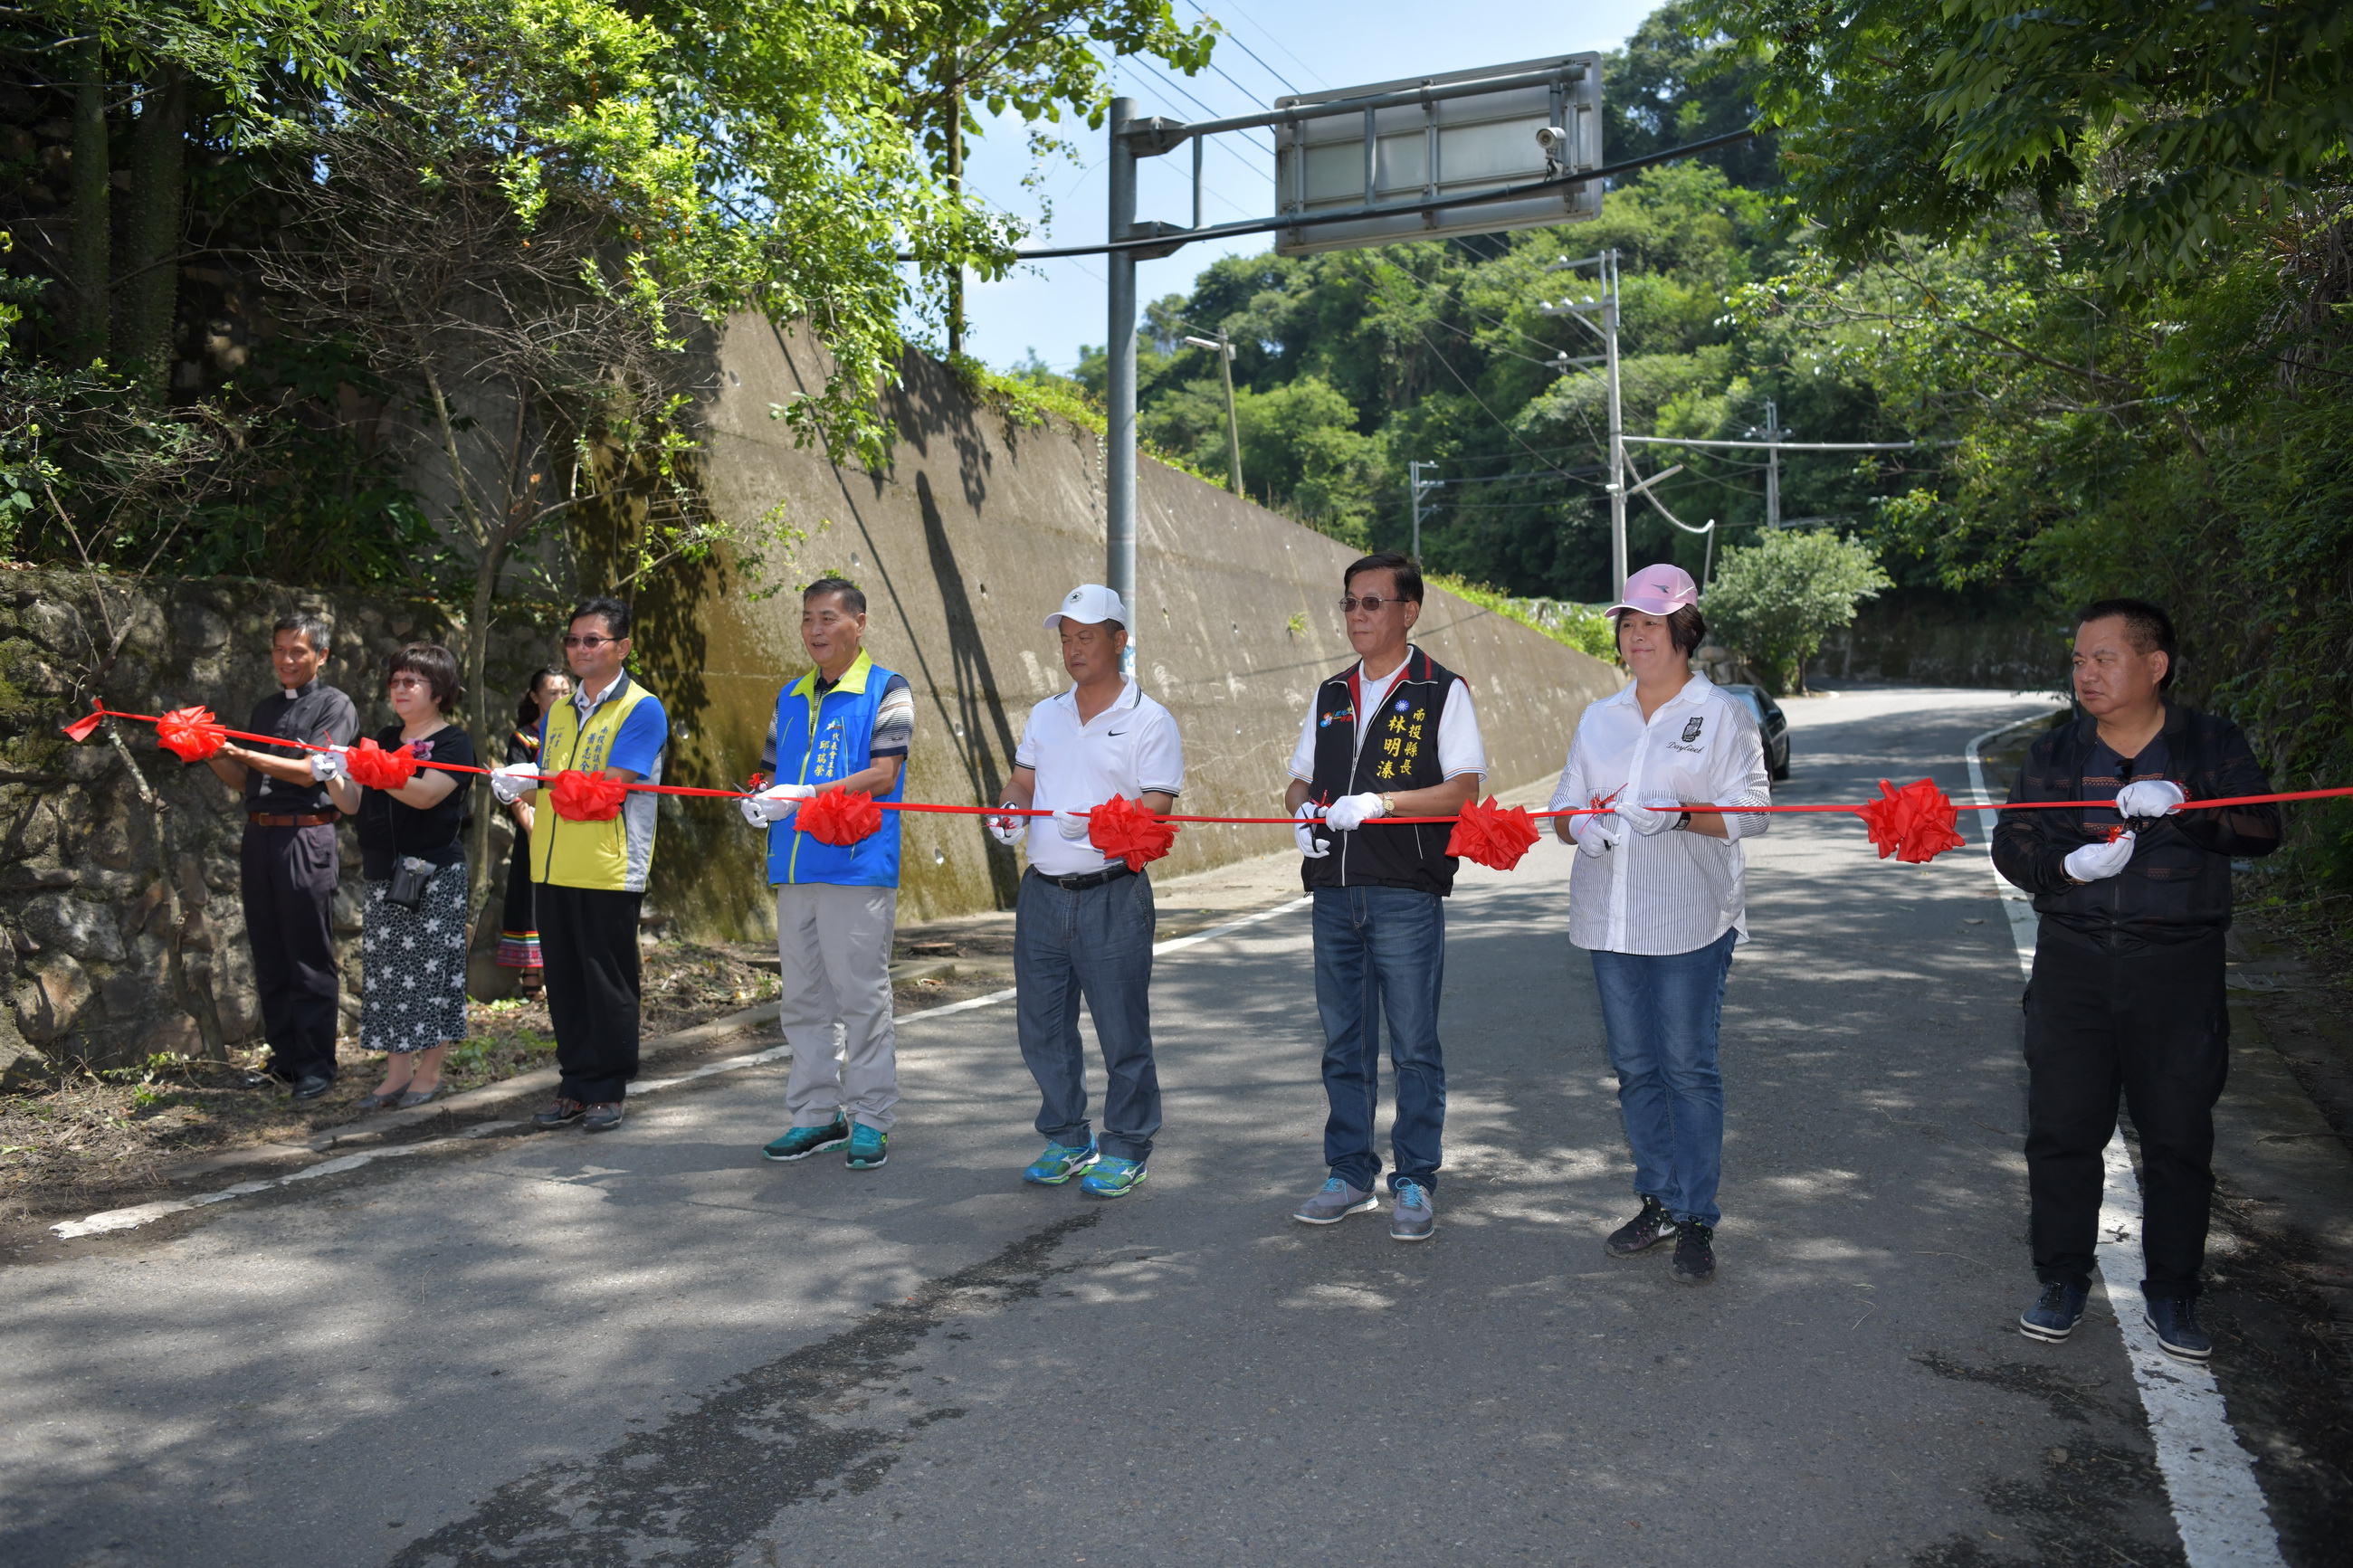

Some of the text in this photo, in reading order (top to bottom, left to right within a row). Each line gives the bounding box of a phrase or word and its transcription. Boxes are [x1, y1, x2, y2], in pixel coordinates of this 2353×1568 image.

[825, 733, 840, 777] 代表會主席
[1377, 715, 1407, 779] 林明溱
[1400, 708, 1425, 775] 南投縣長
